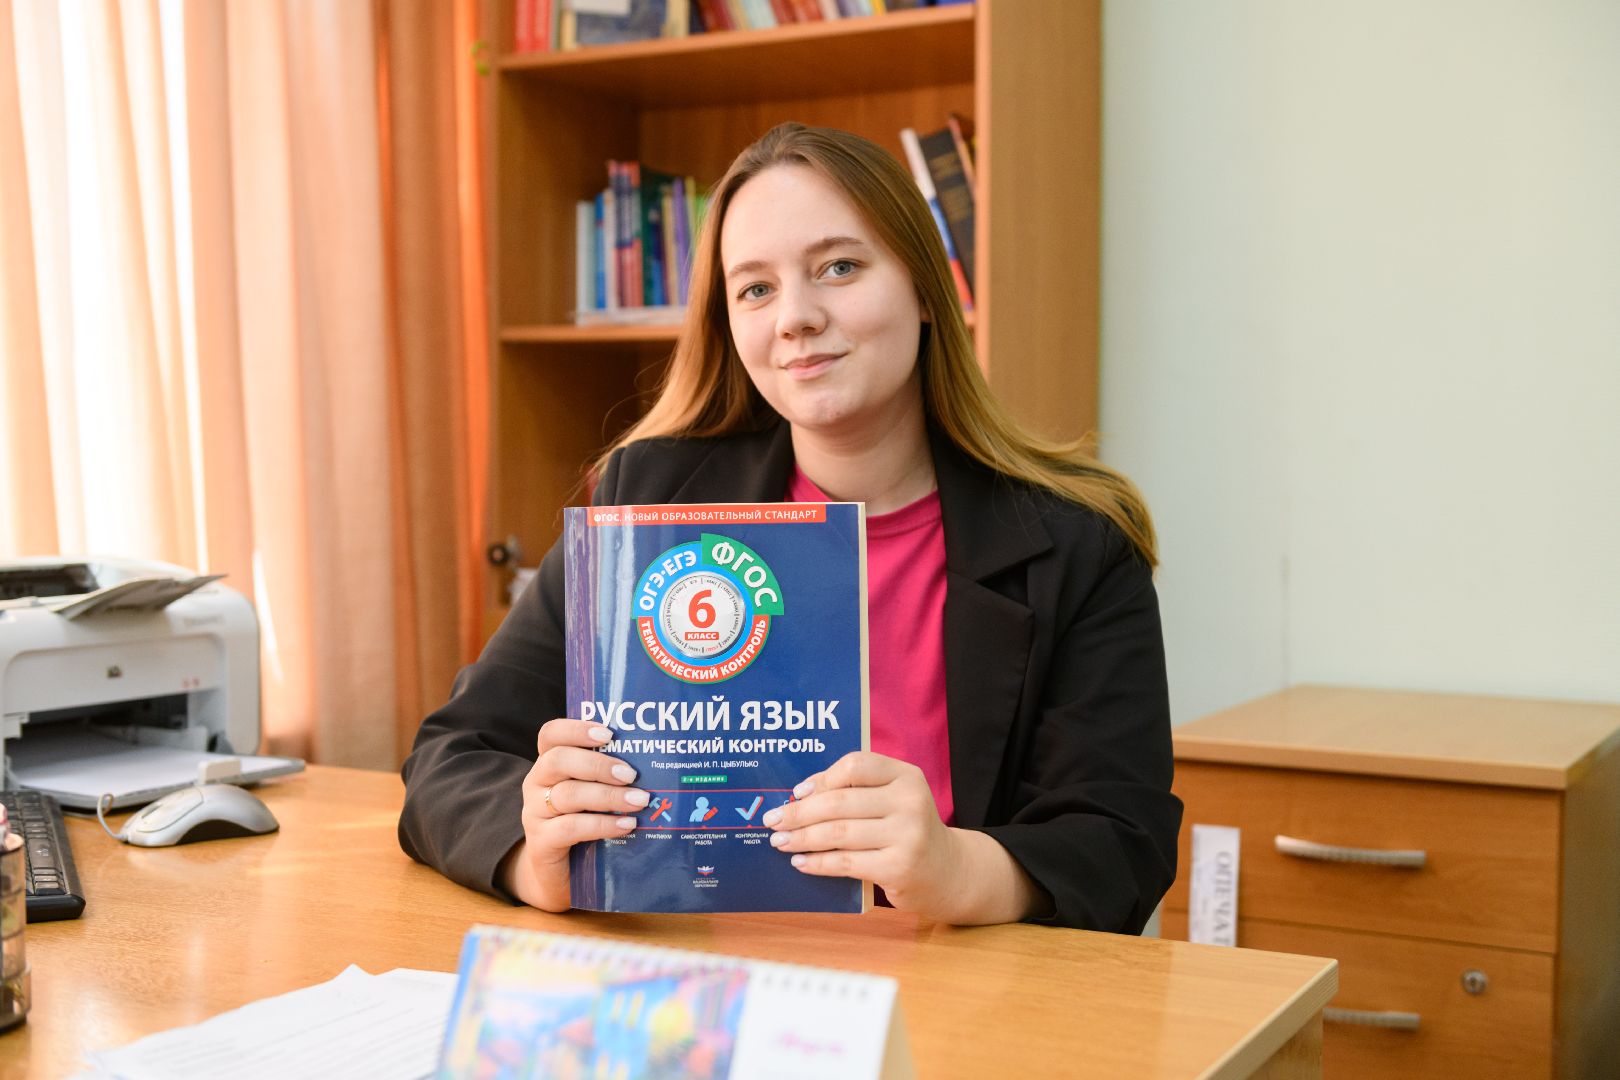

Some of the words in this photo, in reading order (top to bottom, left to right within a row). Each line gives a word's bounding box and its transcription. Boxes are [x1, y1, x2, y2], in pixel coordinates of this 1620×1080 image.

[624, 511, 658, 521] НОВЫЙ
[662, 510, 762, 520] ОБРАЗОВАТЕЛЬНЫЙ
[765, 510, 817, 519] СТАНДАРТ
[712, 542, 778, 607] ФГОС
[689, 590, 716, 628] 6
[640, 620, 719, 680] ТЕМАТИЧЕСКИЙ
[720, 619, 766, 677] КОНТРОЛЬ
[581, 695, 730, 732] РУССКИЙ
[739, 700, 840, 730] ЯЗЫК
[728, 738, 825, 753] КОНТРОЛЬ
[666, 761, 702, 769] редакцией
[721, 760, 759, 768] ЦЫБУЛЬКО
